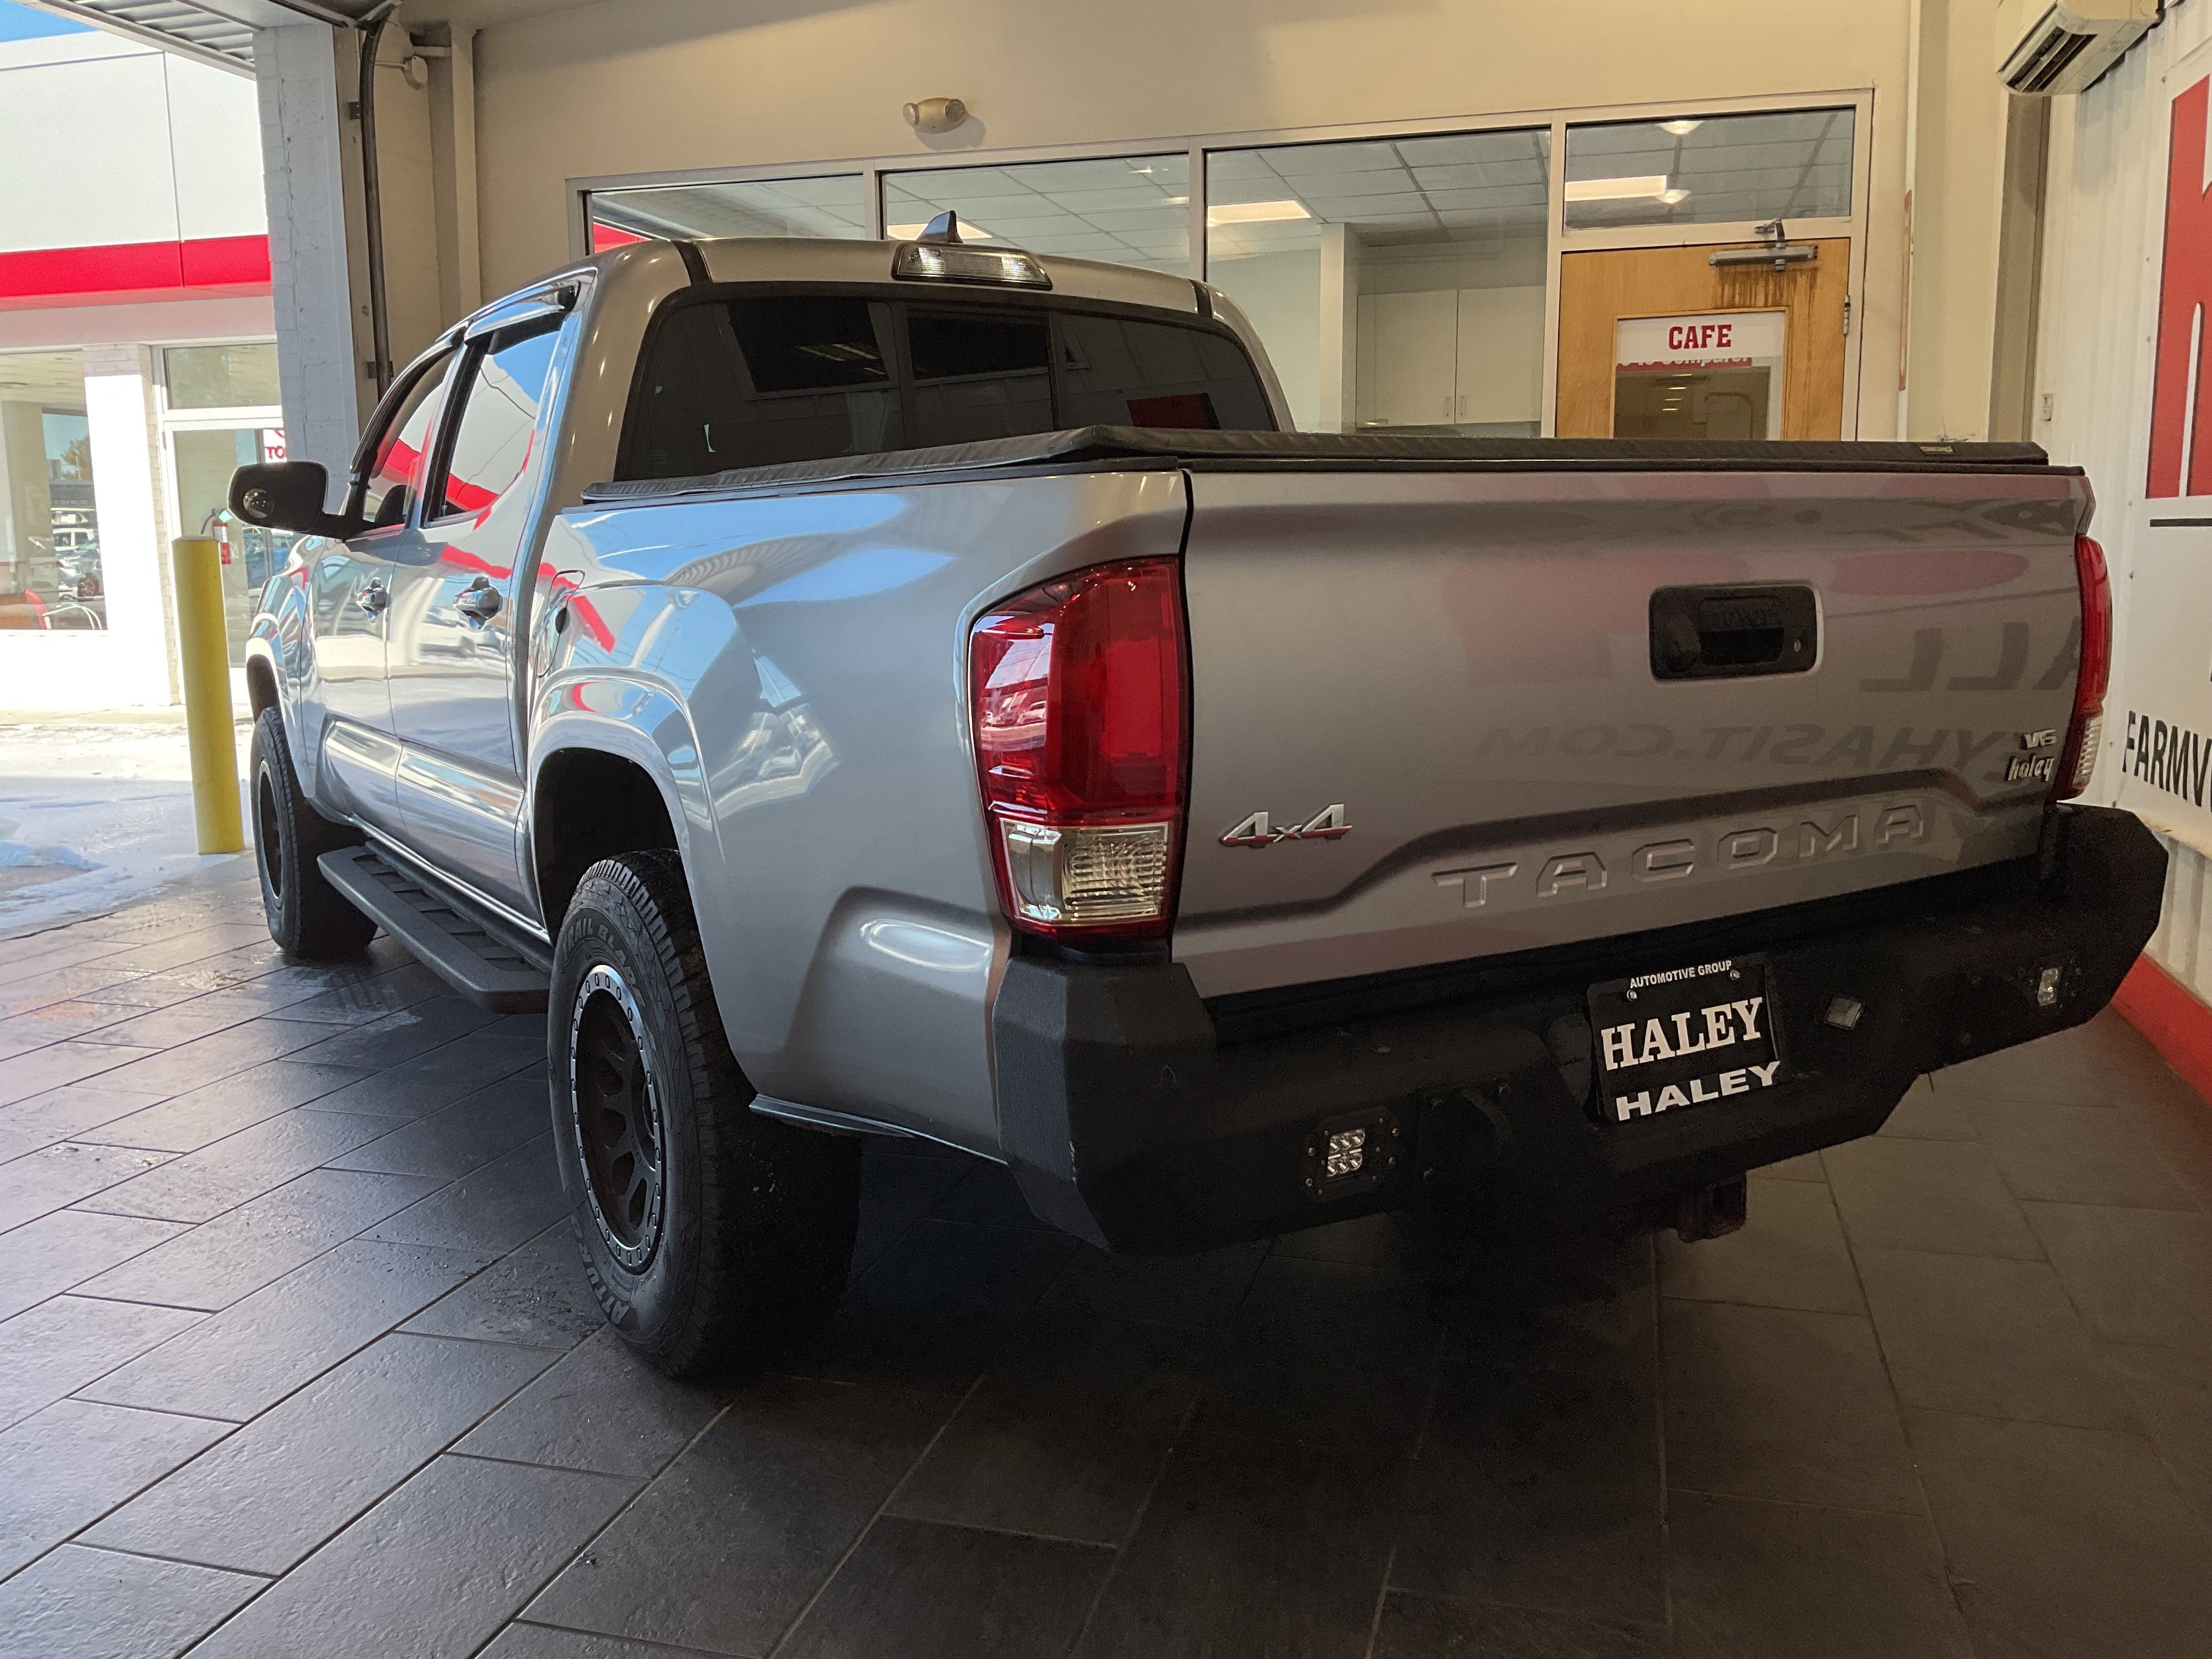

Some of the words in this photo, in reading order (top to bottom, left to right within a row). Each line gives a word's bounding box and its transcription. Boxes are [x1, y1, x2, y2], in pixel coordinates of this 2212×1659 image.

[1668, 324, 1732, 350] CAFE
[2006, 754, 2055, 782] haley
[2023, 729, 2057, 749] V6
[2121, 710, 2212, 813] FARMV
[1220, 803, 1353, 848] 4x4
[1430, 804, 1924, 909] TACOMA
[561, 917, 594, 961] TRAIL
[597, 924, 646, 1008] BLADE
[1630, 966, 1696, 989] AUTOMOTIVE
[1697, 960, 1733, 977] GROUP
[1600, 996, 1763, 1071] HALEY
[1616, 1060, 1781, 1121] HALEY
[571, 1214, 630, 1324] ATTURO
